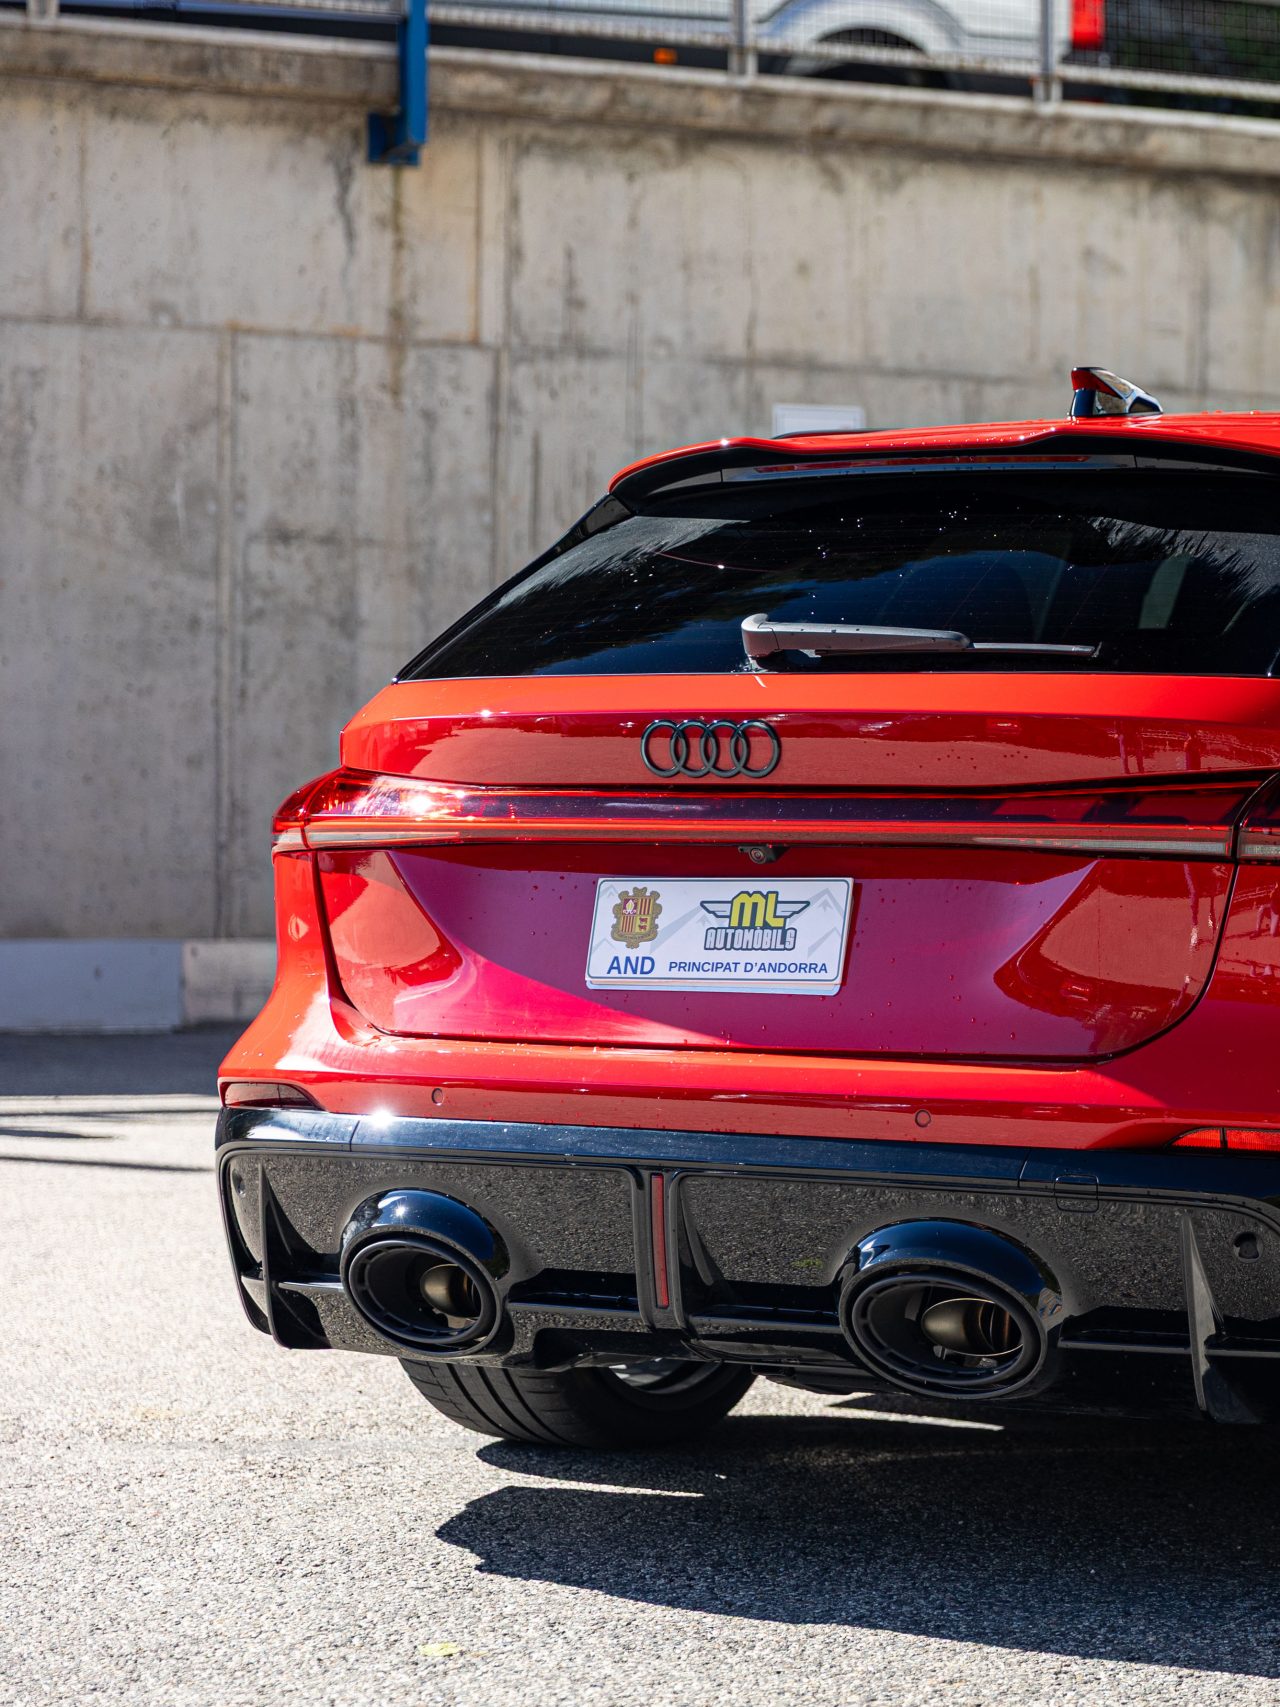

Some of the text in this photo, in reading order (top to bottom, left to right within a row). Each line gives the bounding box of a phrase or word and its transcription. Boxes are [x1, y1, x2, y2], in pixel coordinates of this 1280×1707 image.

[729, 891, 786, 927] ML
[606, 955, 829, 975] AND PRINCIPAT D'ANDORRA
